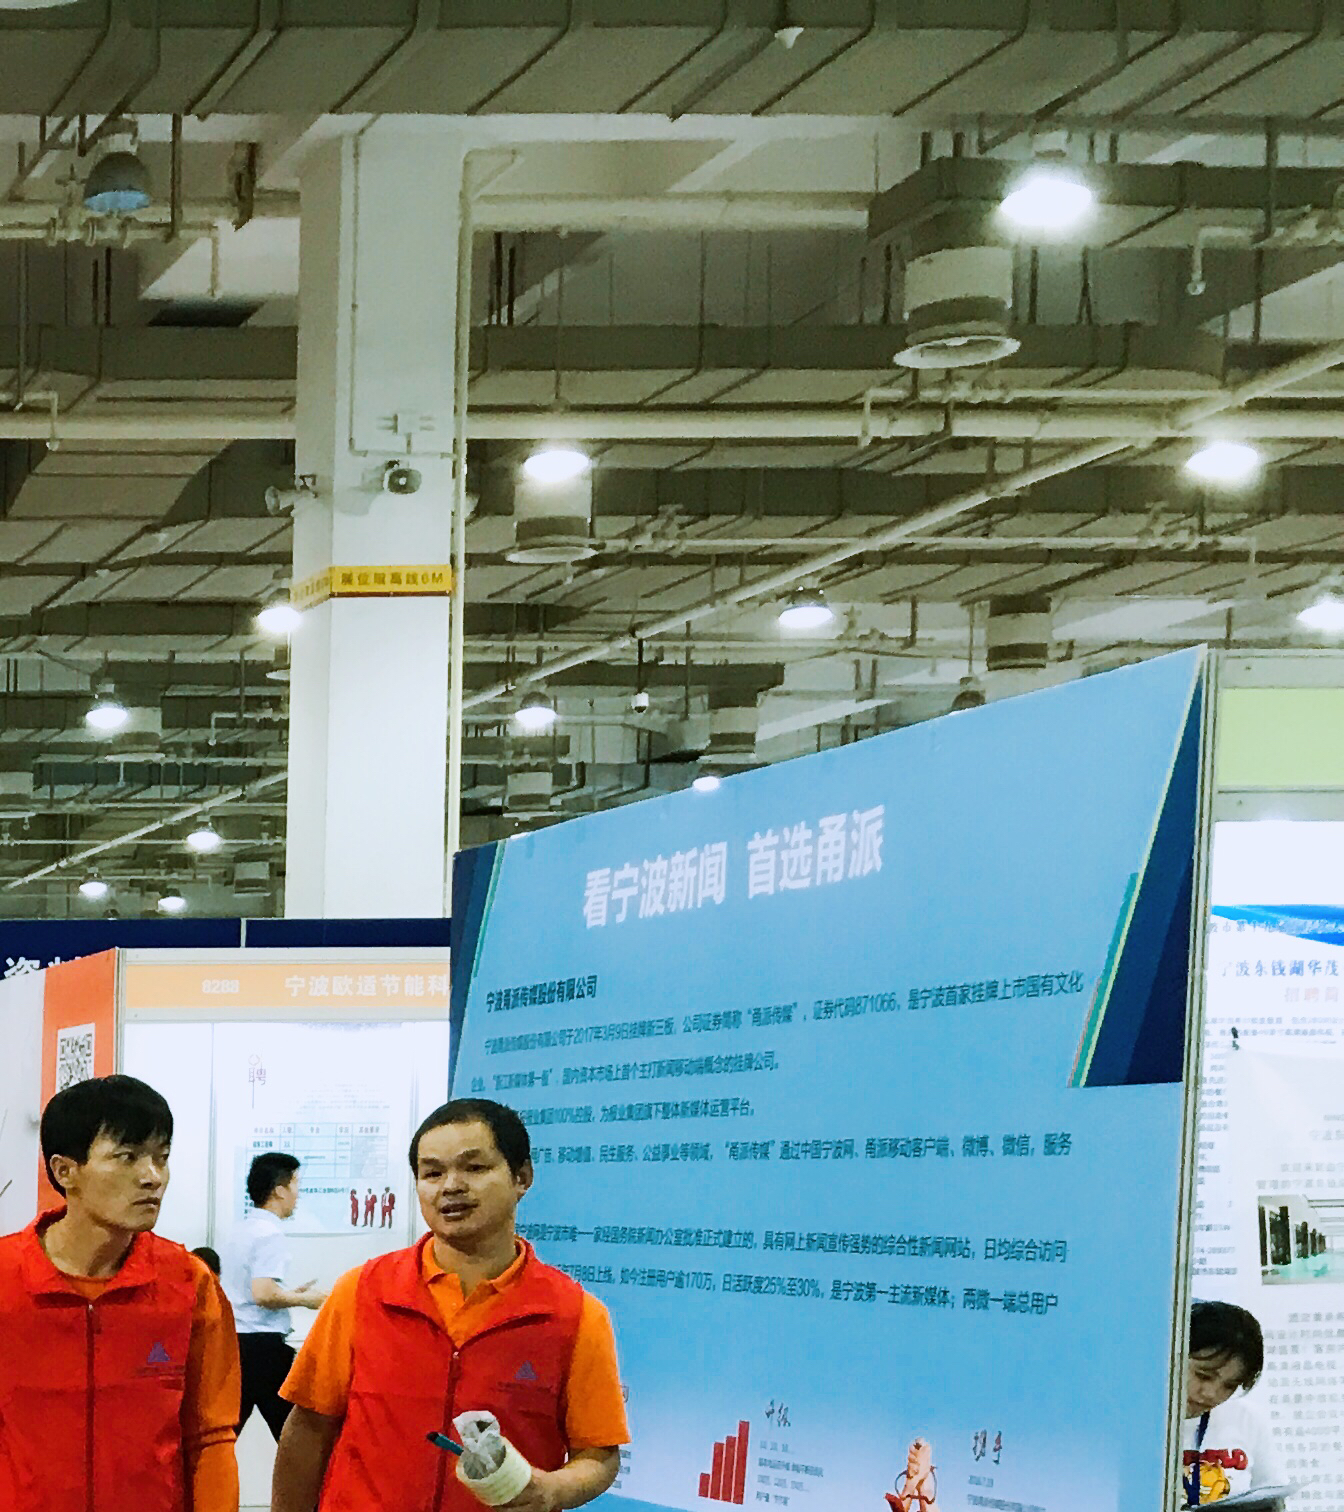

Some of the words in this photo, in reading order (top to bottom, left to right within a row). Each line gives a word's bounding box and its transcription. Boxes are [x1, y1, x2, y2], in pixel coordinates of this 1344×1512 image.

[583, 841, 728, 929] 看宁波新闻
[746, 804, 885, 899] 首选甬派
[485, 973, 599, 1014] 宁波甬派传媒股份有限公司
